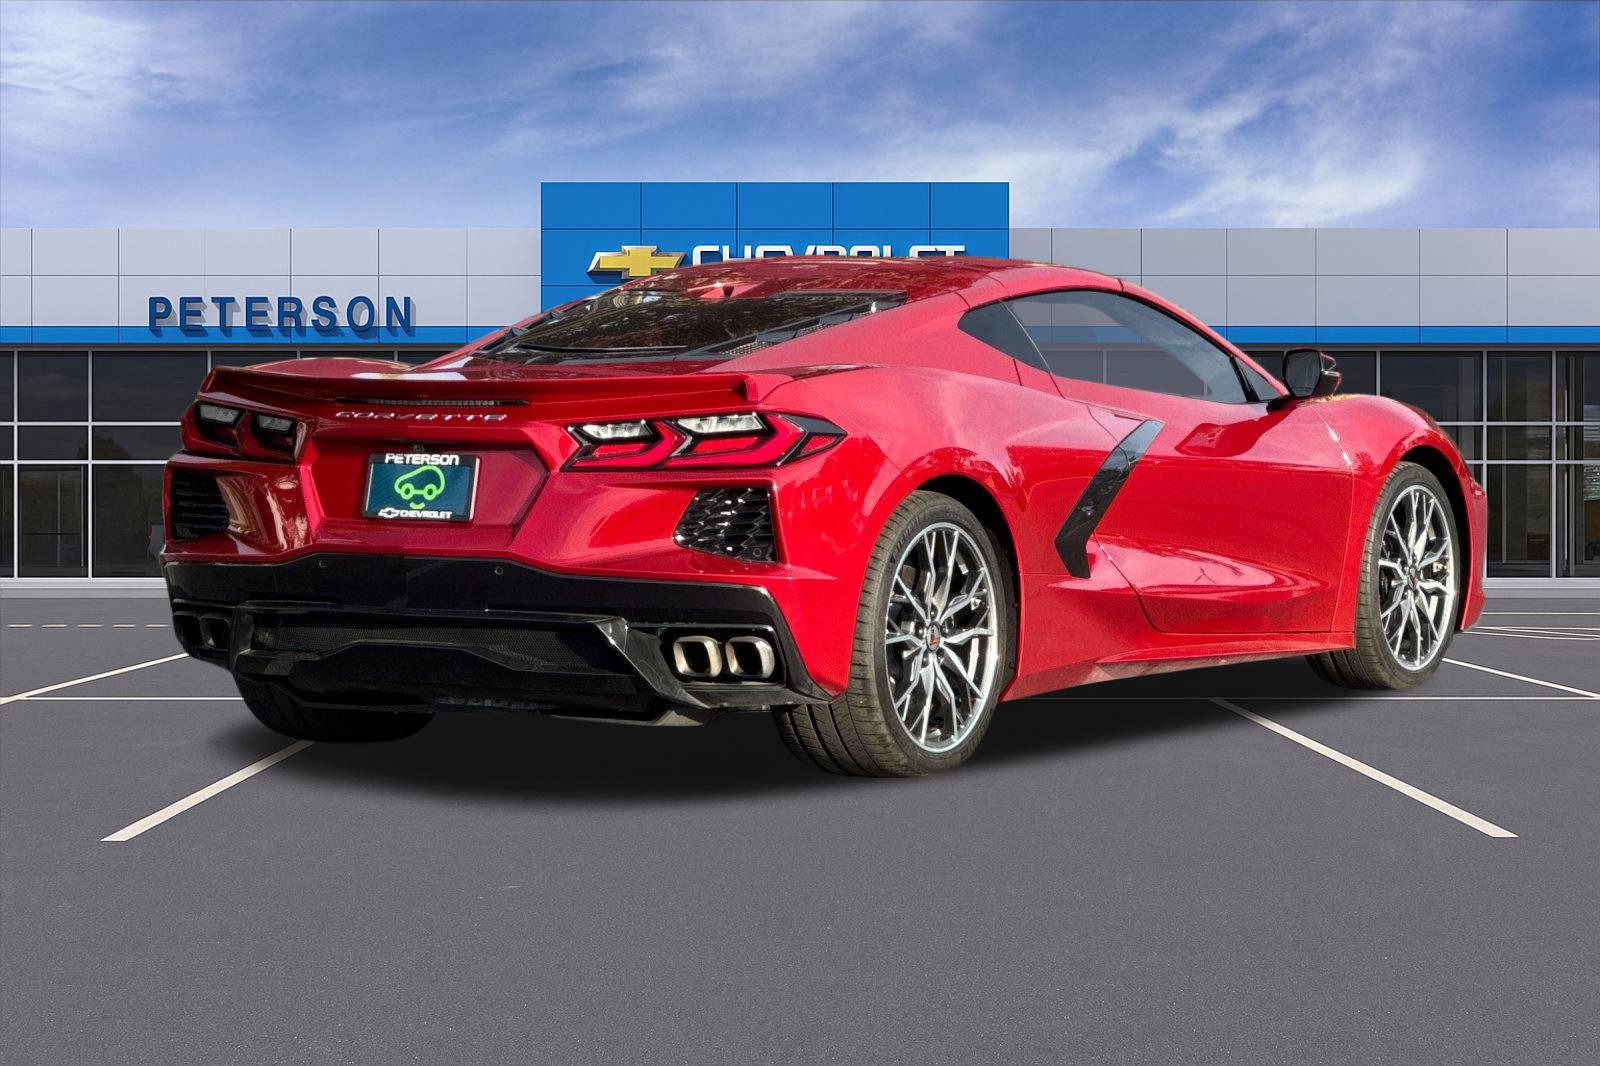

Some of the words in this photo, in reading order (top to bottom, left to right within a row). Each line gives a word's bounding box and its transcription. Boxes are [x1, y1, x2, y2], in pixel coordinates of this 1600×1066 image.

[149, 296, 411, 332] PETERSON
[335, 411, 508, 421] CORVETTE
[385, 453, 460, 466] PETERSON
[400, 508, 453, 519] CHEVROLET
